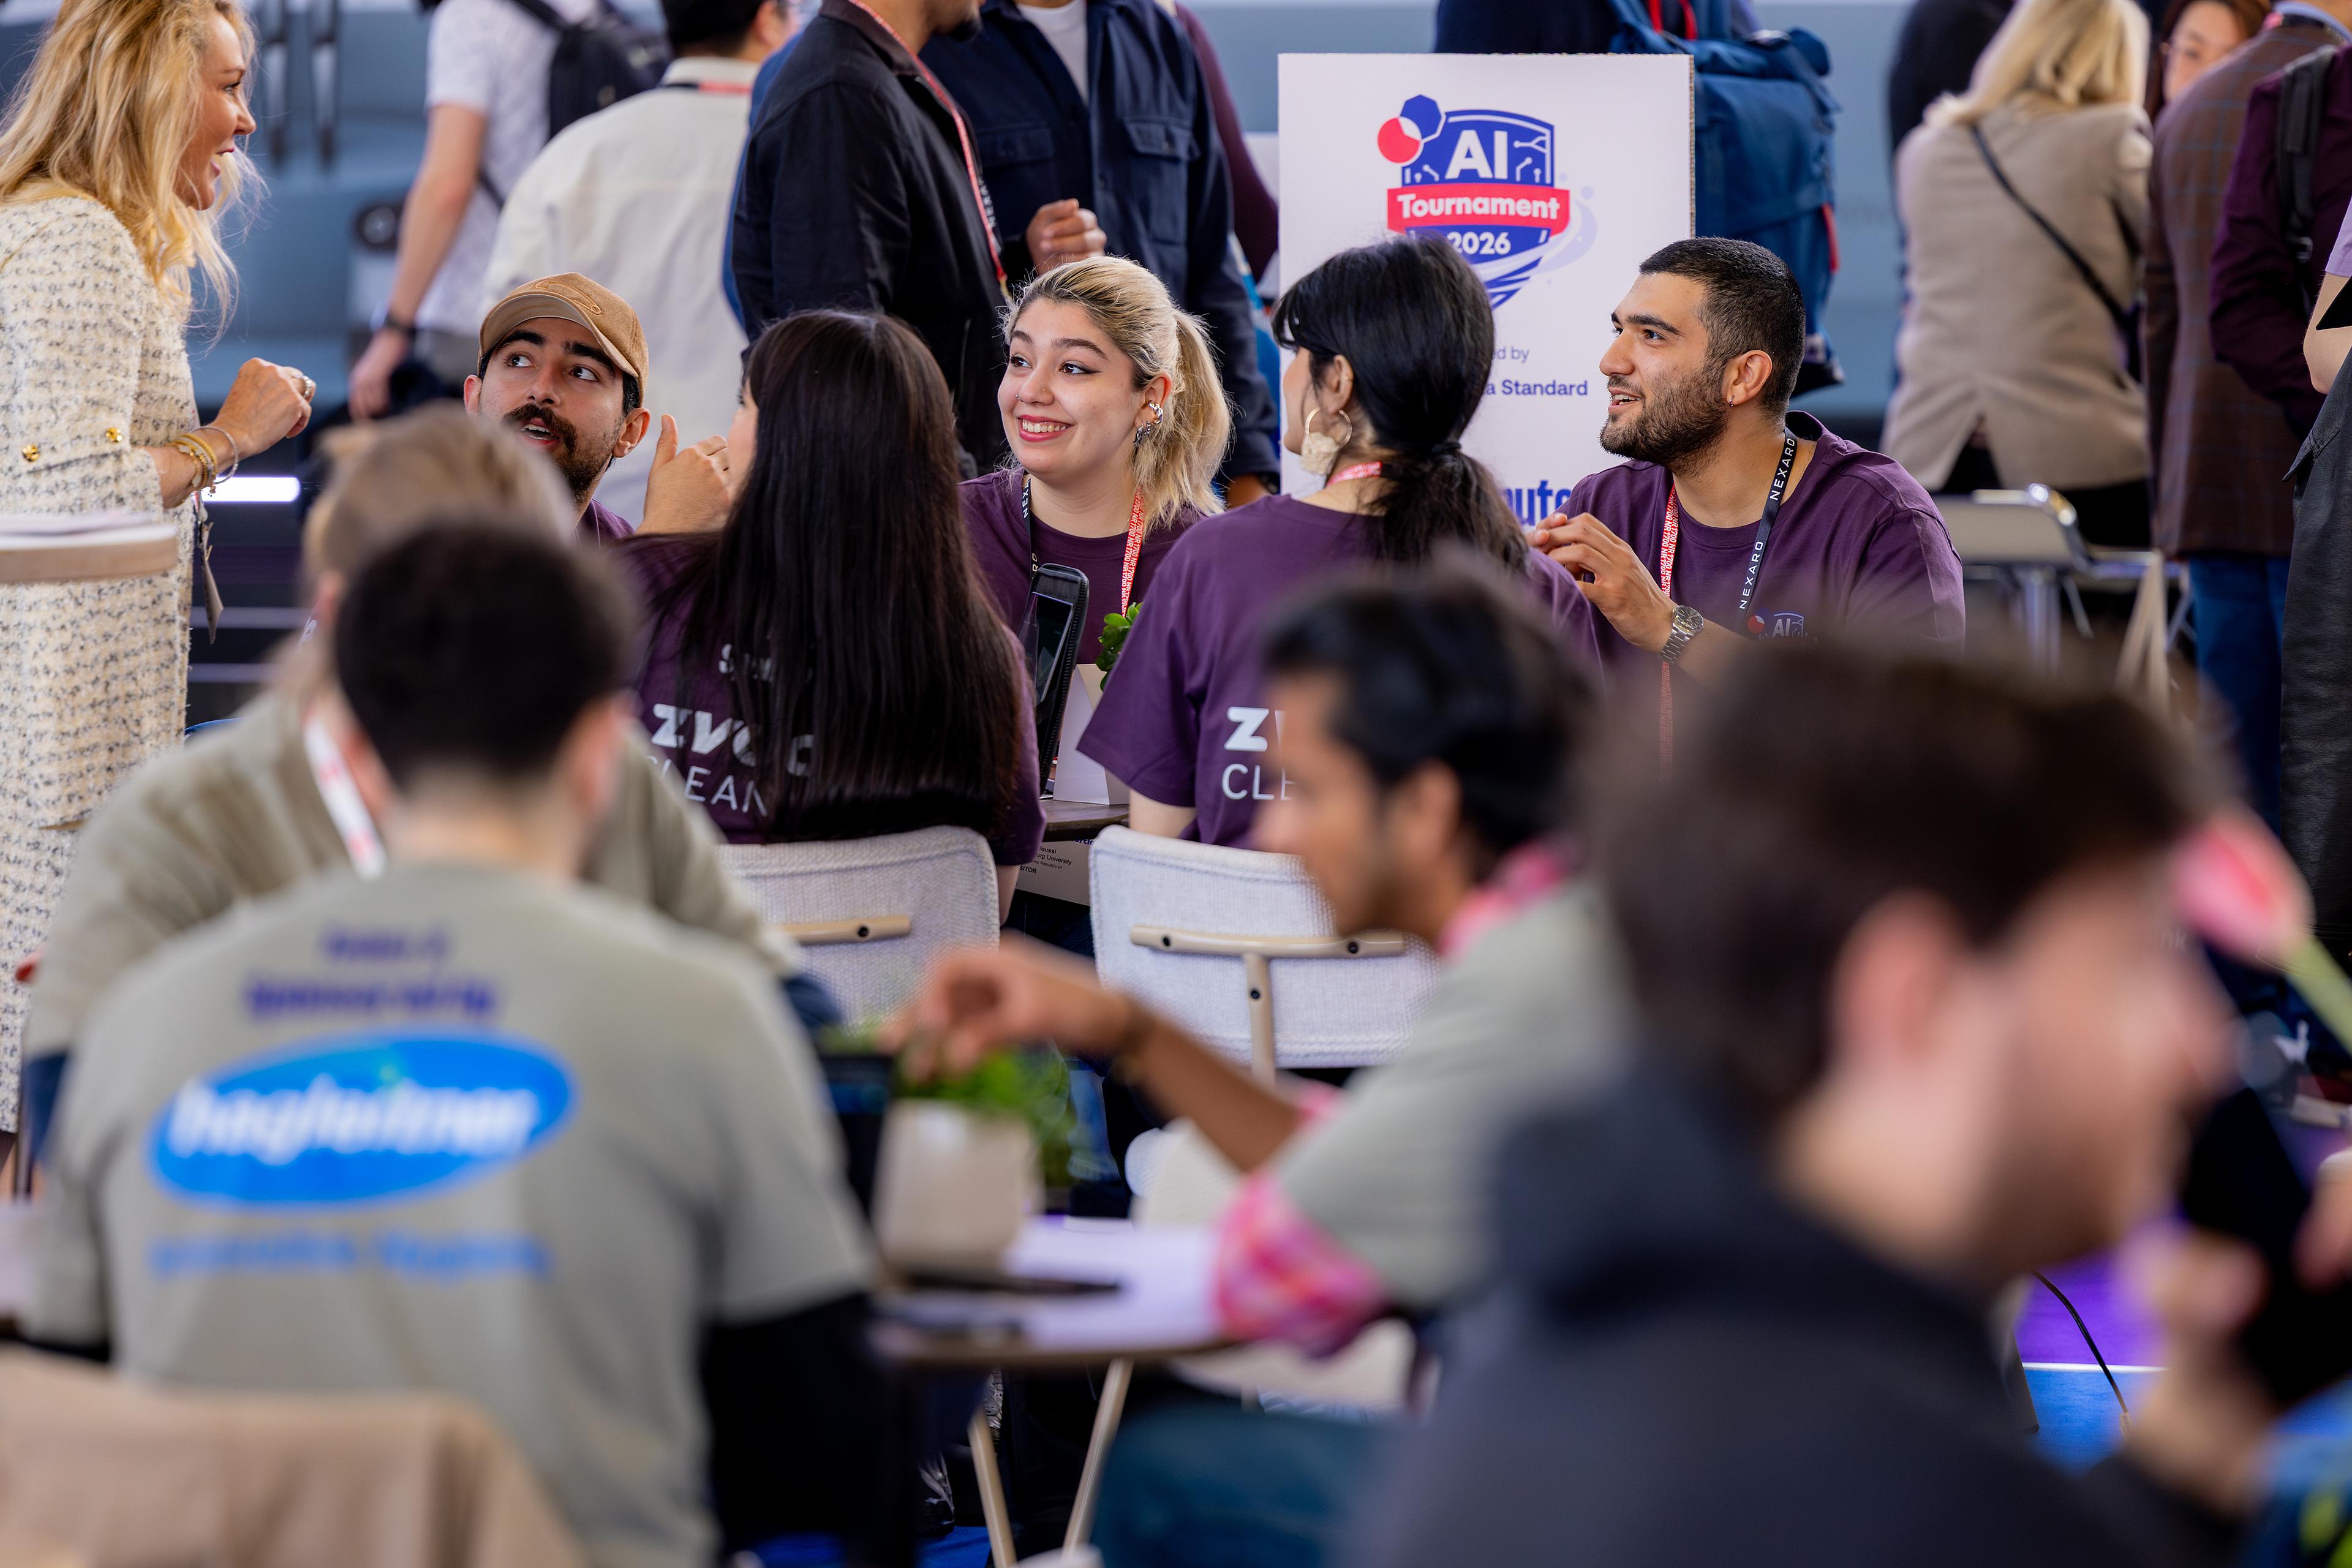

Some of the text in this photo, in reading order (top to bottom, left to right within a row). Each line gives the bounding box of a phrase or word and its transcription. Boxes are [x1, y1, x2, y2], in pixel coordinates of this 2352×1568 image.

[1445, 129, 1508, 179] AI
[1396, 194, 1560, 219] Tournament
[1447, 231, 1511, 255] 2026
[1511, 346, 1530, 363] by
[1502, 379, 1588, 396] Standard
[1770, 438, 1795, 500] NEXARO
[1662, 521, 1672, 547] NR1700
[1124, 537, 1134, 562] NR1700
[1665, 543, 1676, 569] NR1700
[1126, 557, 1137, 581] NR1700
[1740, 541, 1763, 609] NEXARO
[1771, 618, 1791, 638] AI
[1047, 854, 1072, 866] University
